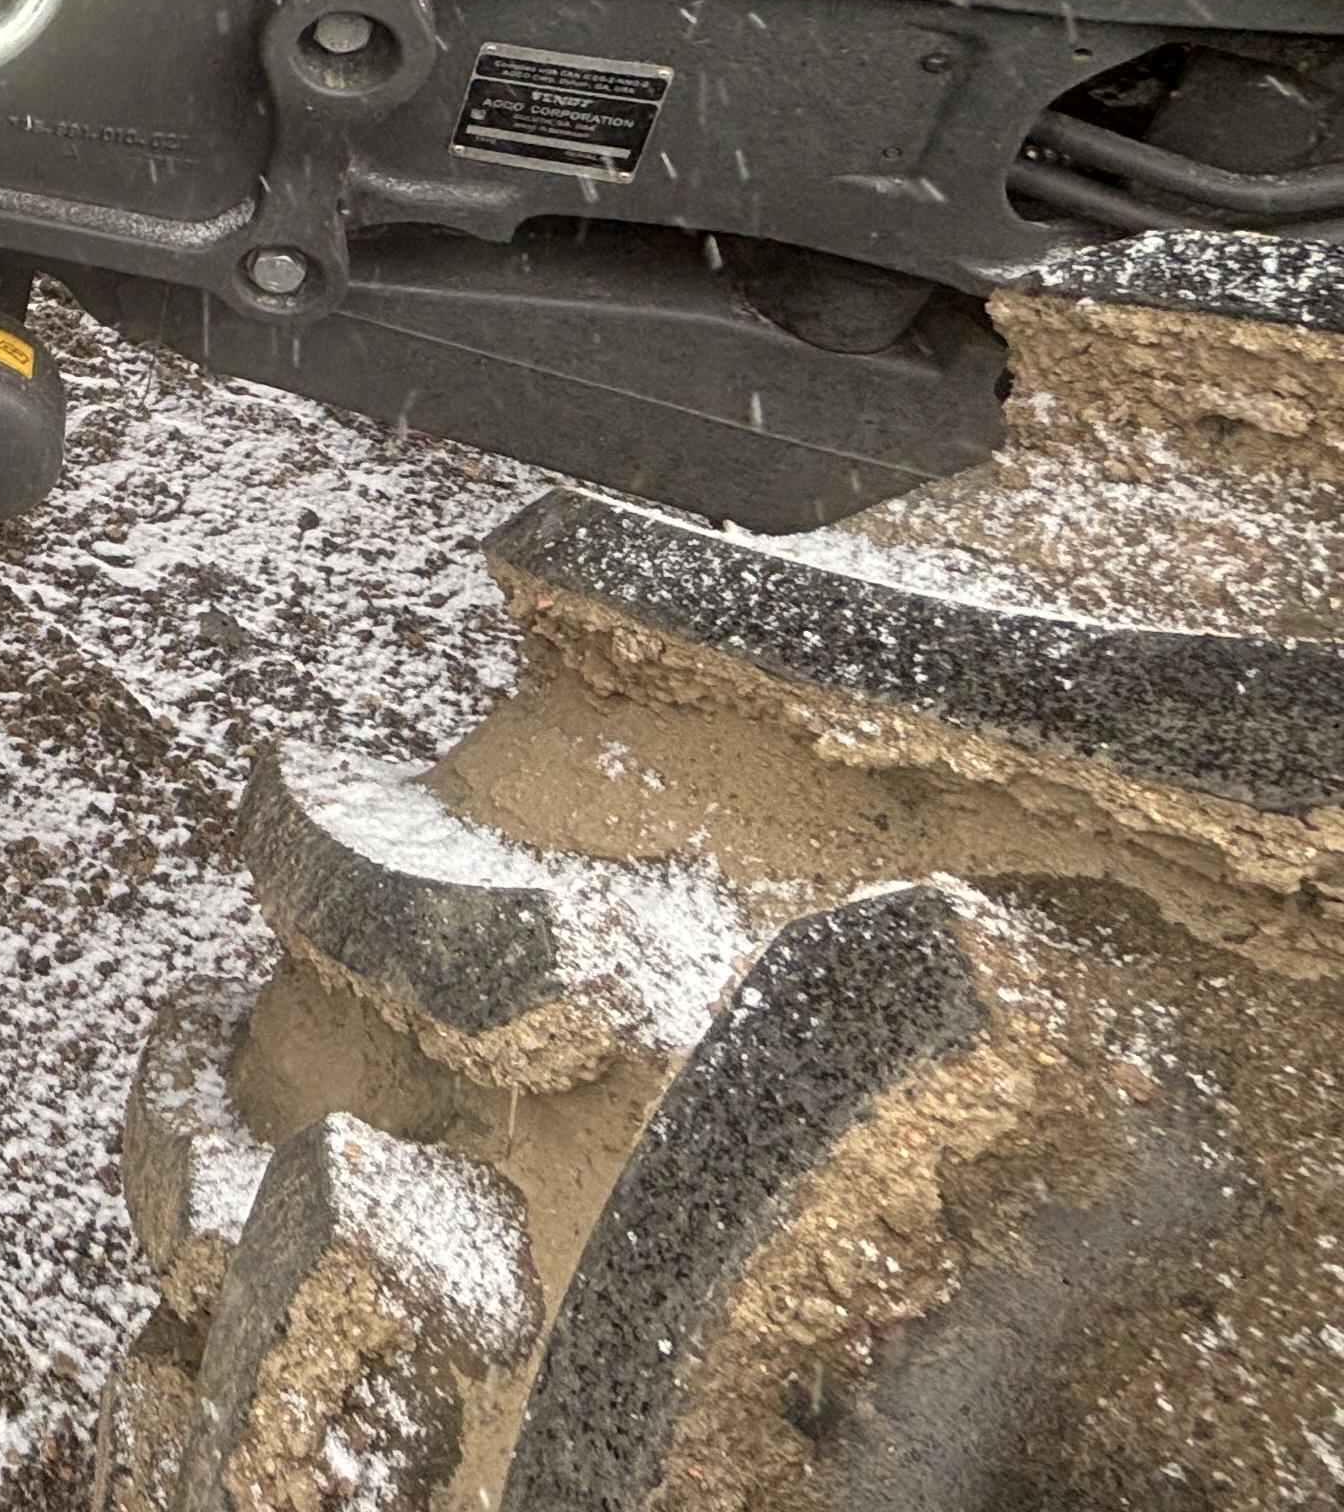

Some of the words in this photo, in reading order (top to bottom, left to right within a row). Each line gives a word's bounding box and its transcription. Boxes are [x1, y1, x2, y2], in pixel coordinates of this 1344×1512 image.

[532, 90, 594, 108] FENDT
[482, 98, 523, 112] AGCO
[530, 105, 635, 128] CORPORATION
